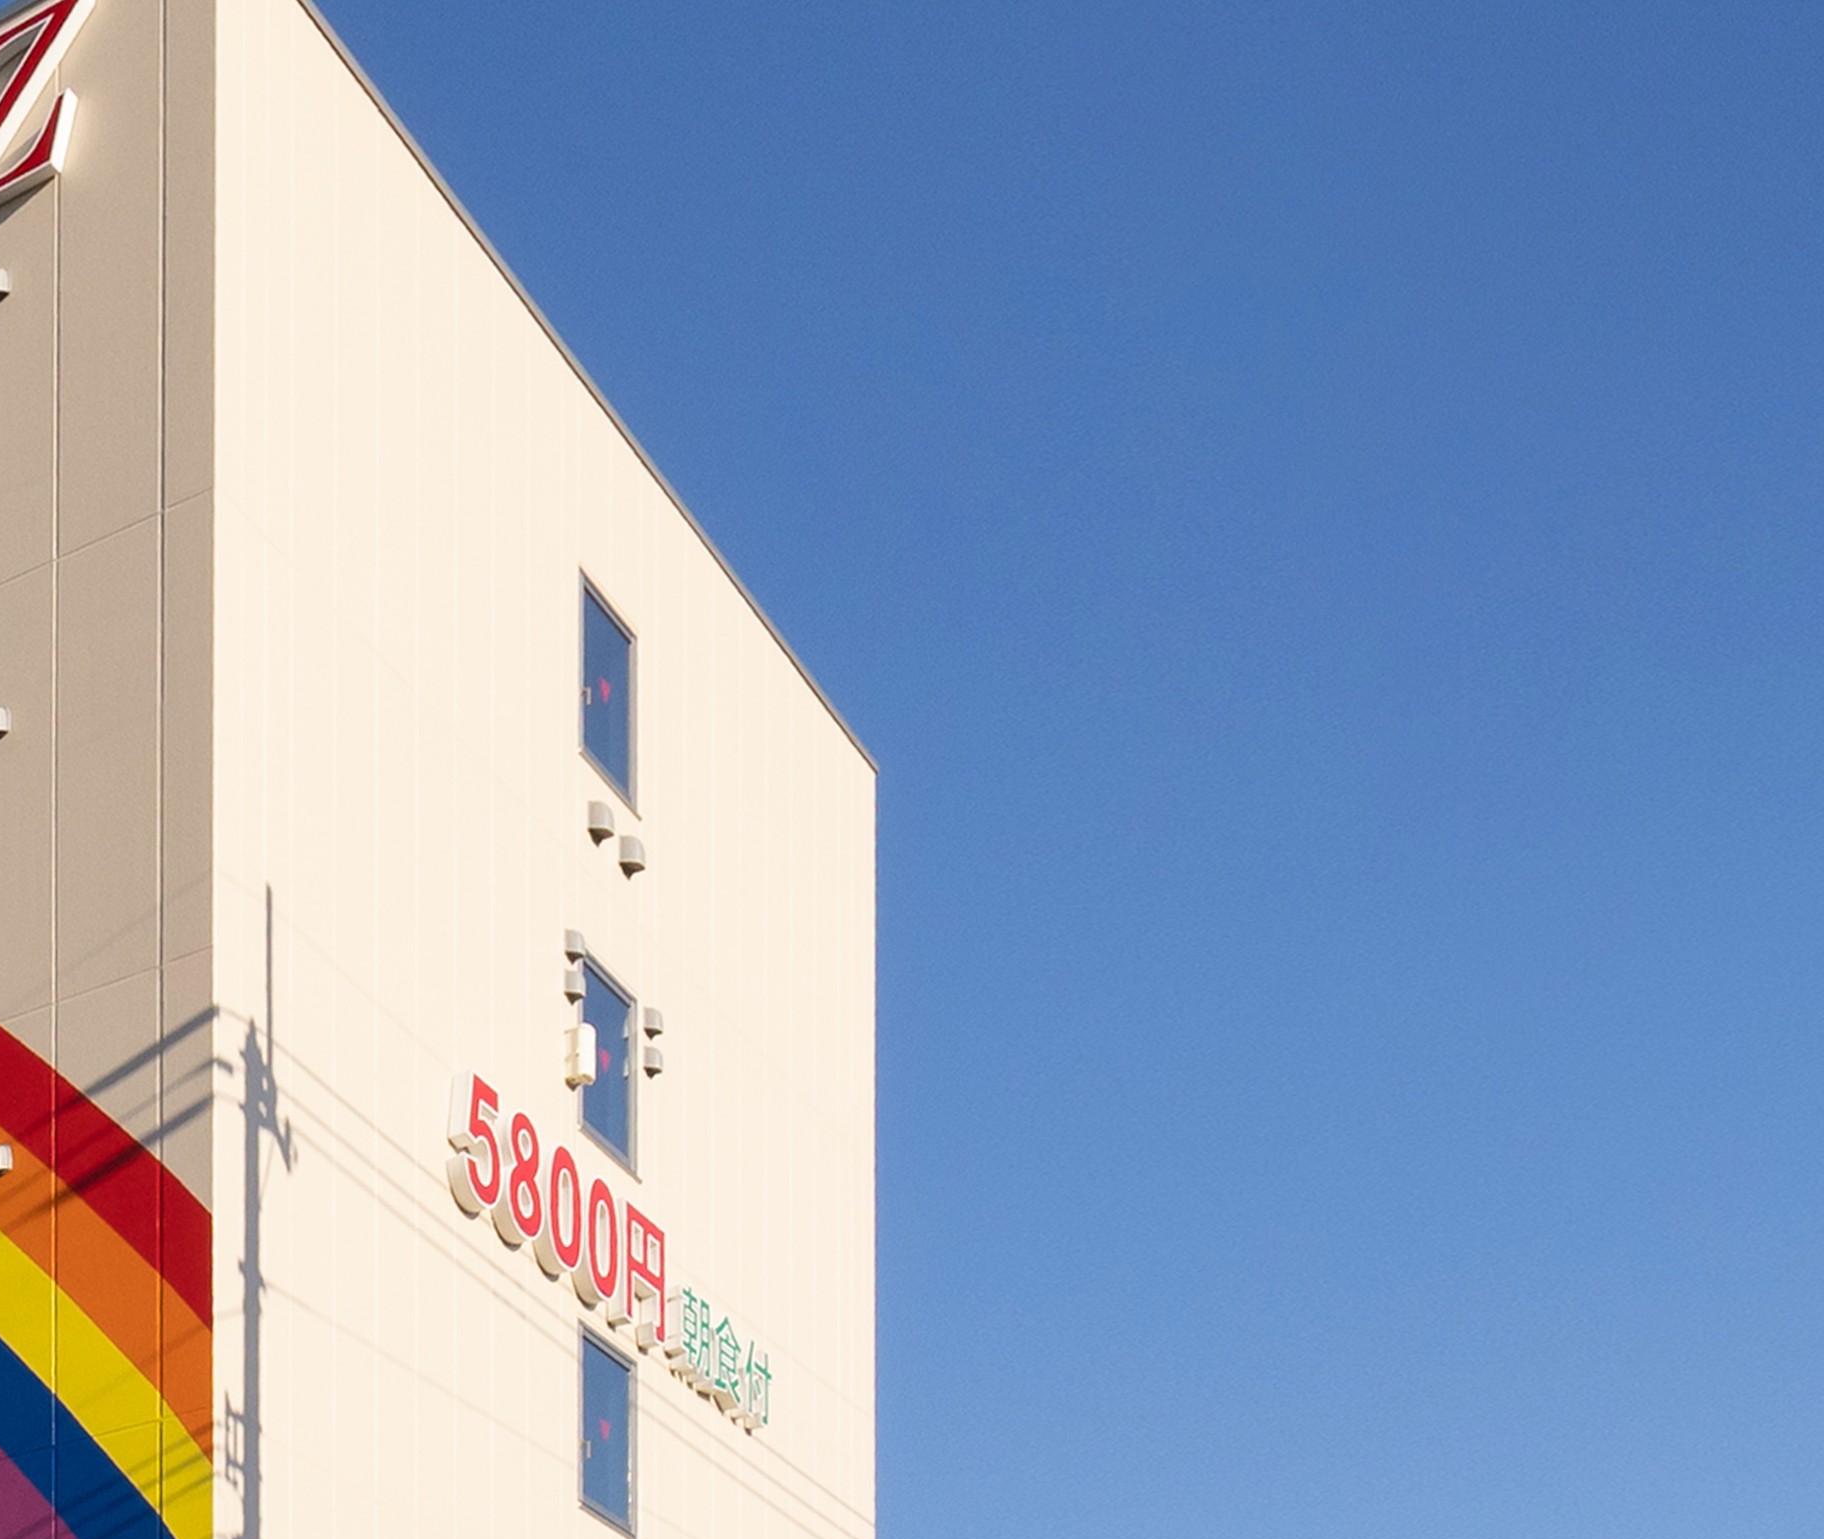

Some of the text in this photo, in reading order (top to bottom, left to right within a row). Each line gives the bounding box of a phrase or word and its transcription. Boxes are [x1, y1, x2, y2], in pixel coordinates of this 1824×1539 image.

[460, 1072, 773, 1426] 5800円 朝食付
